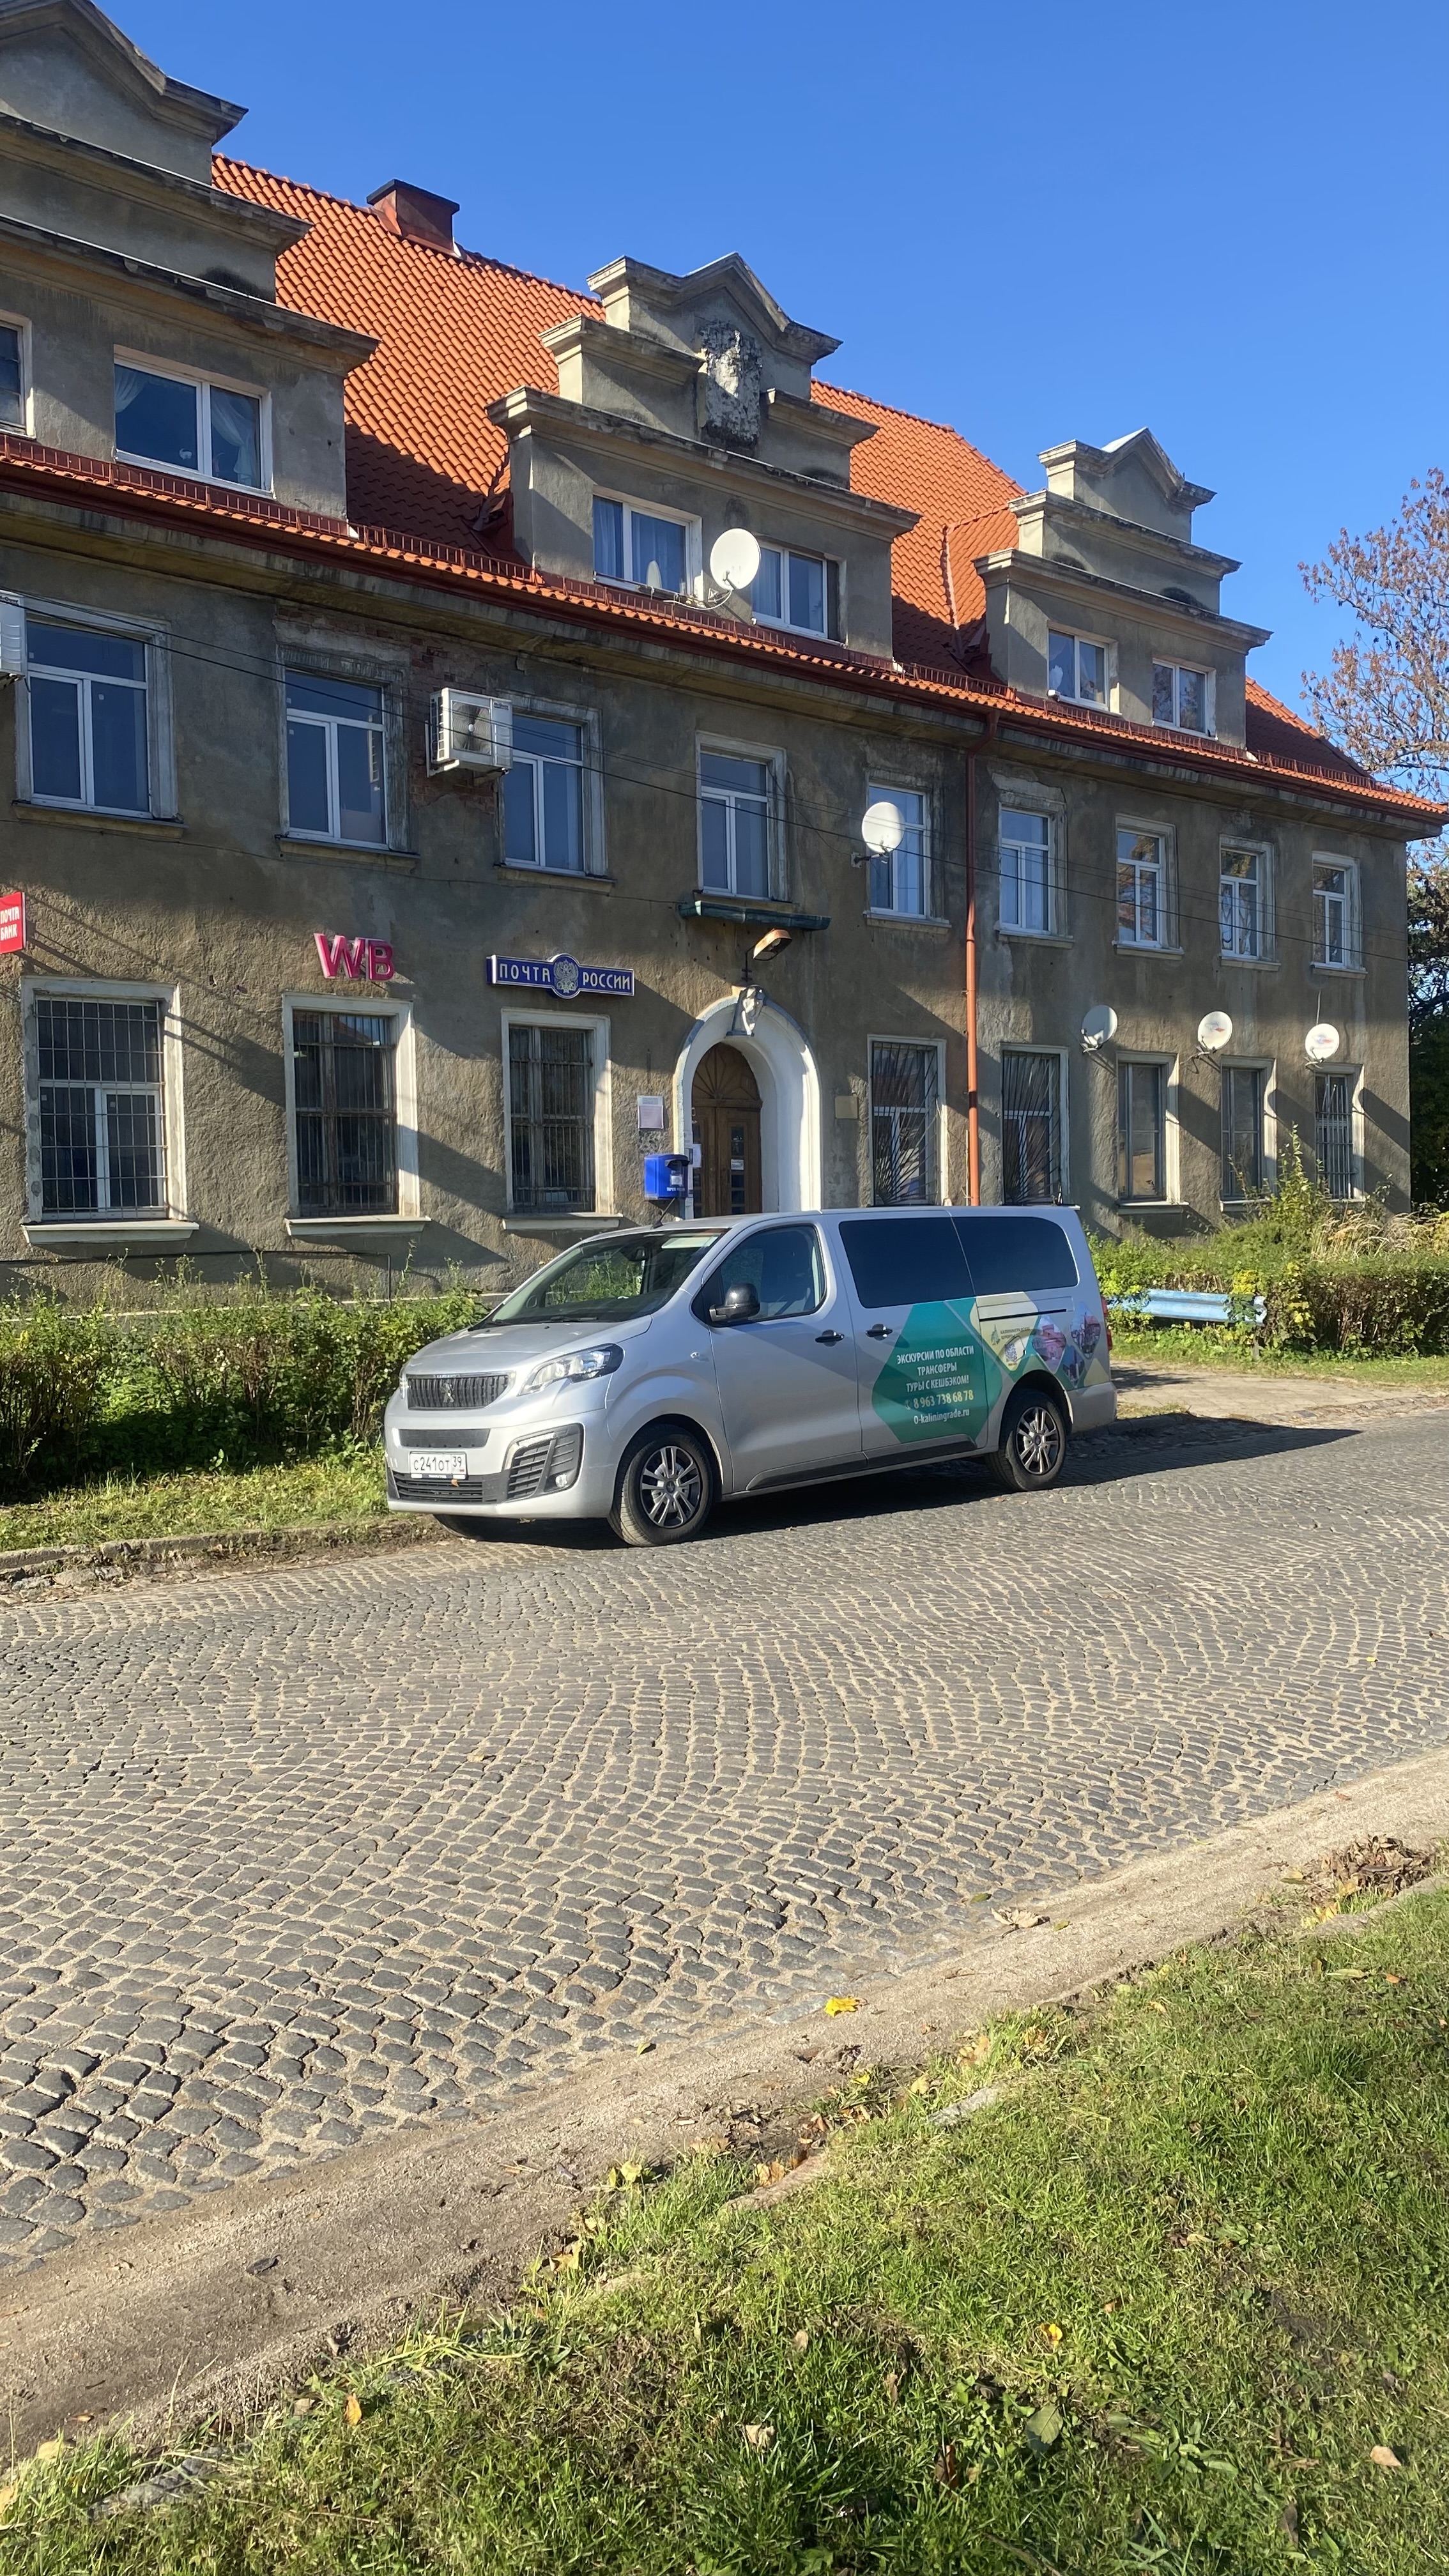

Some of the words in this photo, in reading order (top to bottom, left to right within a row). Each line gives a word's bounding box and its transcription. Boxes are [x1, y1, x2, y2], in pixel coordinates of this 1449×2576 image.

[0, 906, 20, 924] ПОЧТА
[0, 923, 18, 941] БАНК
[313, 933, 395, 982] WB
[499, 963, 551, 983] ПОЧТА
[582, 971, 631, 990] РОССИИ
[896, 1350, 934, 1365] ЭКСКУРСИИ
[935, 1349, 945, 1360] ПО
[945, 1345, 974, 1358] ОБЛАСТИ
[917, 1362, 957, 1376] ТРАНСФЕРЫ
[906, 1381, 924, 1393] ТУРЫ
[925, 1380, 930, 1390] С
[930, 1374, 969, 1389] КЕШБЭКОМ!
[913, 1398, 919, 1409] 8
[920, 1395, 935, 1407] 963
[936, 1393, 952, 1406] 738
[953, 1391, 963, 1403] 68
[963, 1390, 974, 1401] 78
[452, 1456, 462, 1468] 39
